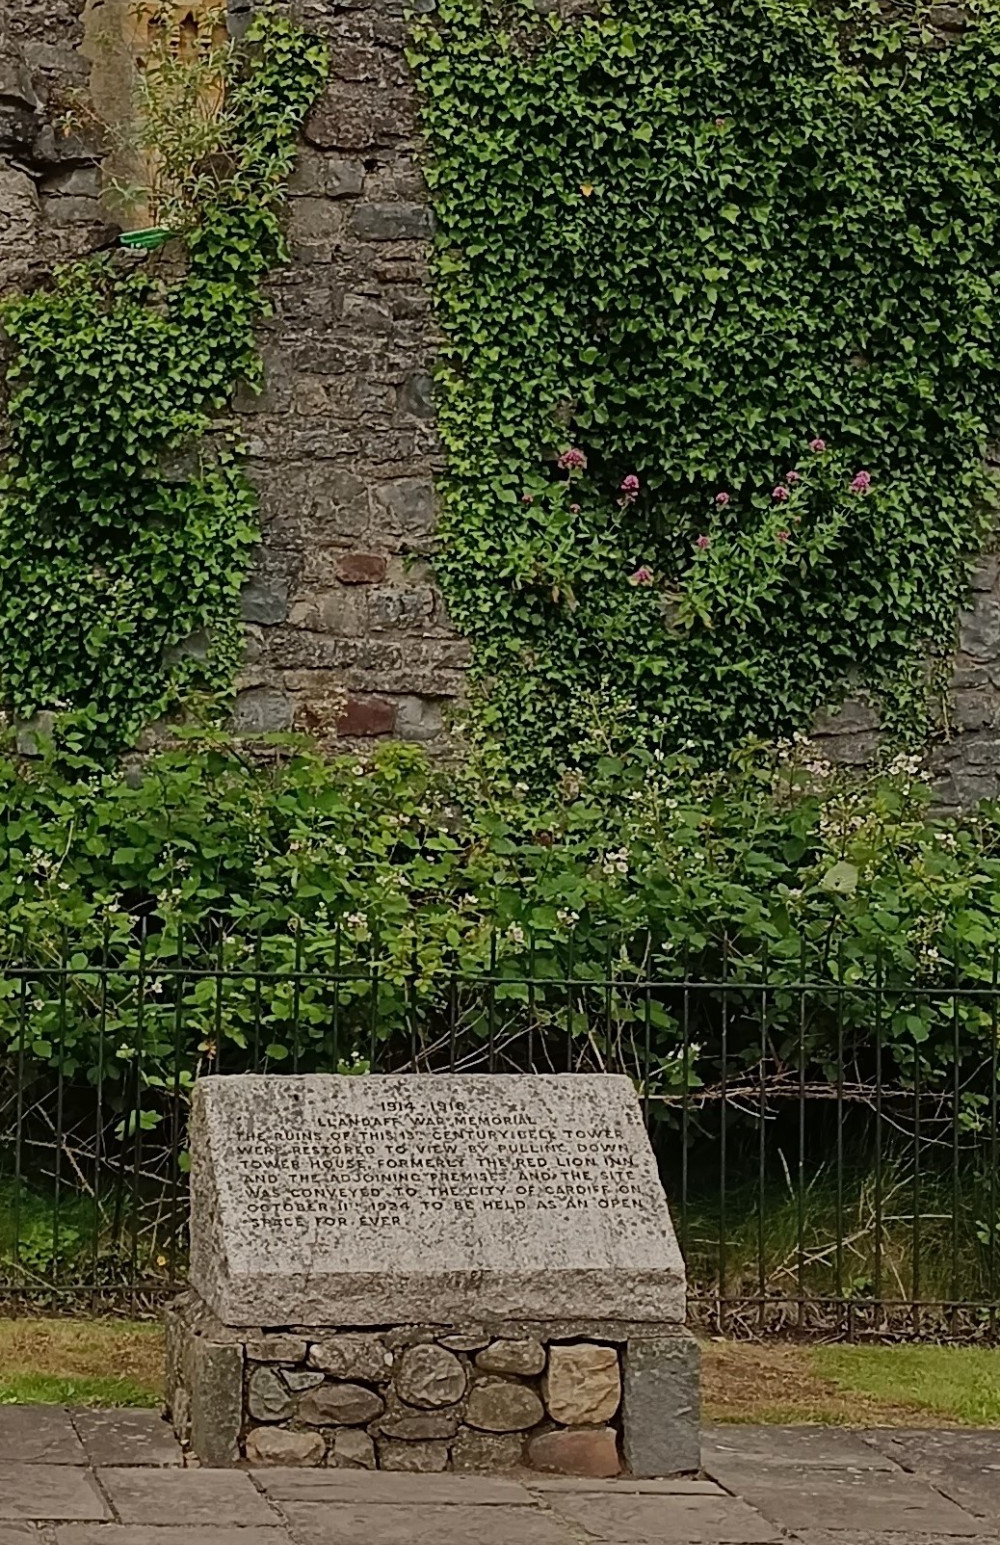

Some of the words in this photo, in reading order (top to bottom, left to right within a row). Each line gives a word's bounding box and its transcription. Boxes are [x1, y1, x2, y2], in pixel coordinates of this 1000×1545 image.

[317, 1117, 400, 1127] LLANDAFF
[410, 1117, 444, 1126] WAR
[455, 1116, 537, 1126] MEMORIAL
[236, 1131, 266, 1141] THE
[275, 1132, 322, 1141] RUINS
[331, 1132, 350, 1141] OF
[360, 1131, 393, 1141] THIS
[432, 1130, 508, 1140] CENTURY
[563, 1128, 623, 1139] TOWER
[237, 1146, 283, 1155] WERE
[292, 1146, 375, 1155] RESTORED
[385, 1145, 406, 1154] TO
[416, 1144, 457, 1154] VIEW
[468, 1144, 488, 1154] BY
[498, 1143, 567, 1154] PULLING
[577, 1142, 629, 1153] DOWN
[240, 1160, 299, 1169] TOWER
[378, 1158, 464, 1168] FORMERLY
[476, 1157, 507, 1168] THE
[516, 1158, 547, 1168] RED
[556, 1157, 598, 1167] LION
[604, 1156, 635, 1166] INN
[244, 1174, 278, 1184] AND
[288, 1174, 319, 1183] THE
[331, 1173, 421, 1183] ADJOINING
[430, 1173, 507, 1182] PREMISES
[560, 1171, 592, 1181] THE
[600, 1171, 635, 1180] SITE
[245, 1188, 280, 1198] WAS
[290, 1188, 380, 1197] CONVEYED
[394, 1187, 417, 1196] TO
[428, 1186, 460, 1196] THE
[469, 1186, 506, 1196] CITY
[516, 1185, 535, 1195] OF
[544, 1185, 610, 1195] CARDIFF
[619, 1184, 641, 1194] ON
[247, 1203, 327, 1213] OCTOBER
[421, 1201, 443, 1211] TO
[454, 1201, 475, 1210] BE
[483, 1200, 526, 1210] HELD
[537, 1200, 557, 1209] AS
[566, 1199, 588, 1209] AN
[598, 1198, 643, 1209] OPEN
[250, 1218, 304, 1228] SPACE
[315, 1217, 347, 1227] FOR
[360, 1216, 401, 1226] EVER
